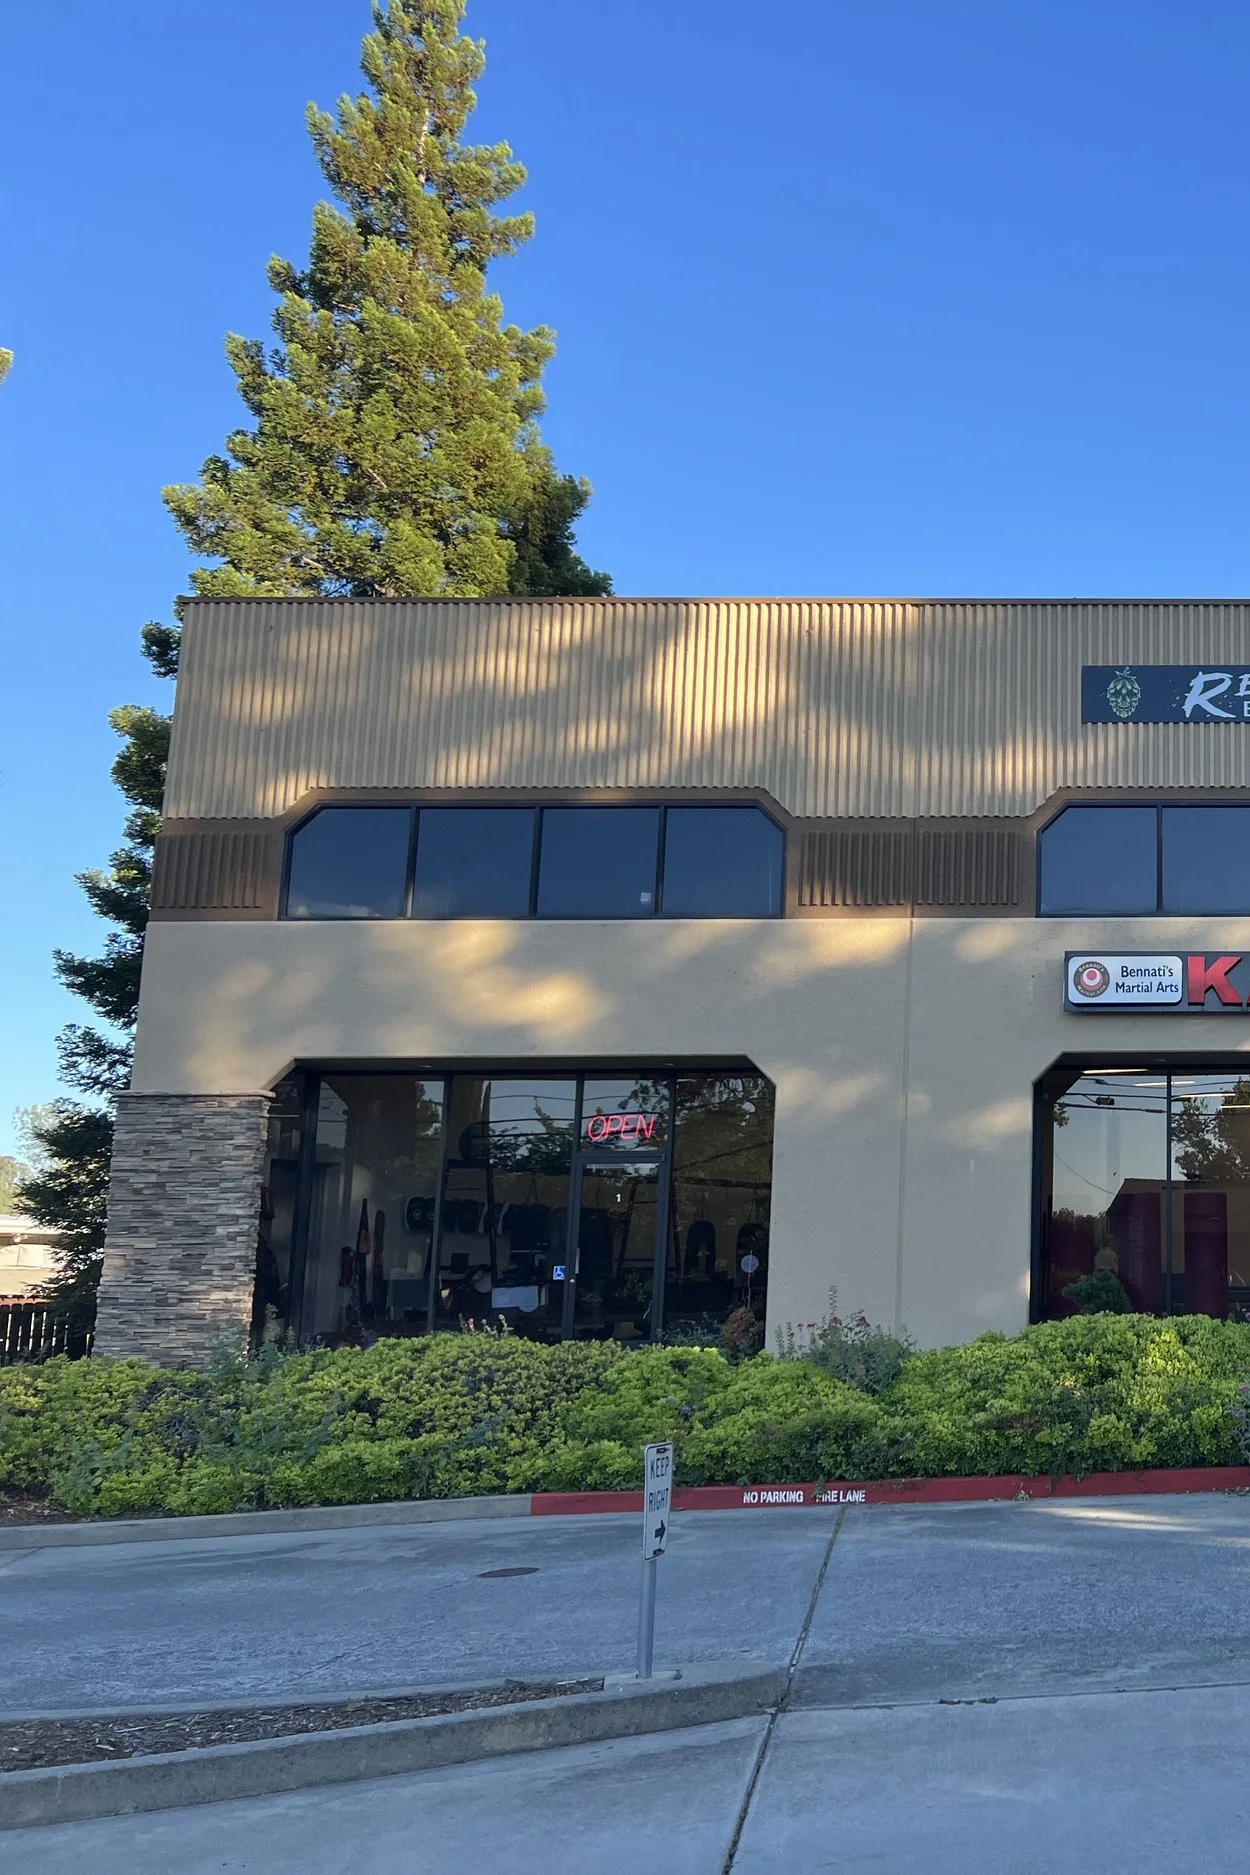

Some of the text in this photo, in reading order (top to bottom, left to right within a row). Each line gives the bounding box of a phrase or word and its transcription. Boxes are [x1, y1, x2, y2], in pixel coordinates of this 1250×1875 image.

[1121, 965, 1174, 978] Bennati's
[1115, 981, 1179, 993] Martial Arts
[587, 1114, 656, 1140] OPEN
[615, 1193, 621, 1203] 1
[650, 1456, 670, 1480] KEEP
[648, 1487, 669, 1513] RIGHT
[743, 1491, 758, 1504] NO
[760, 1490, 804, 1503] PARKING
[839, 1489, 866, 1503] LANE
